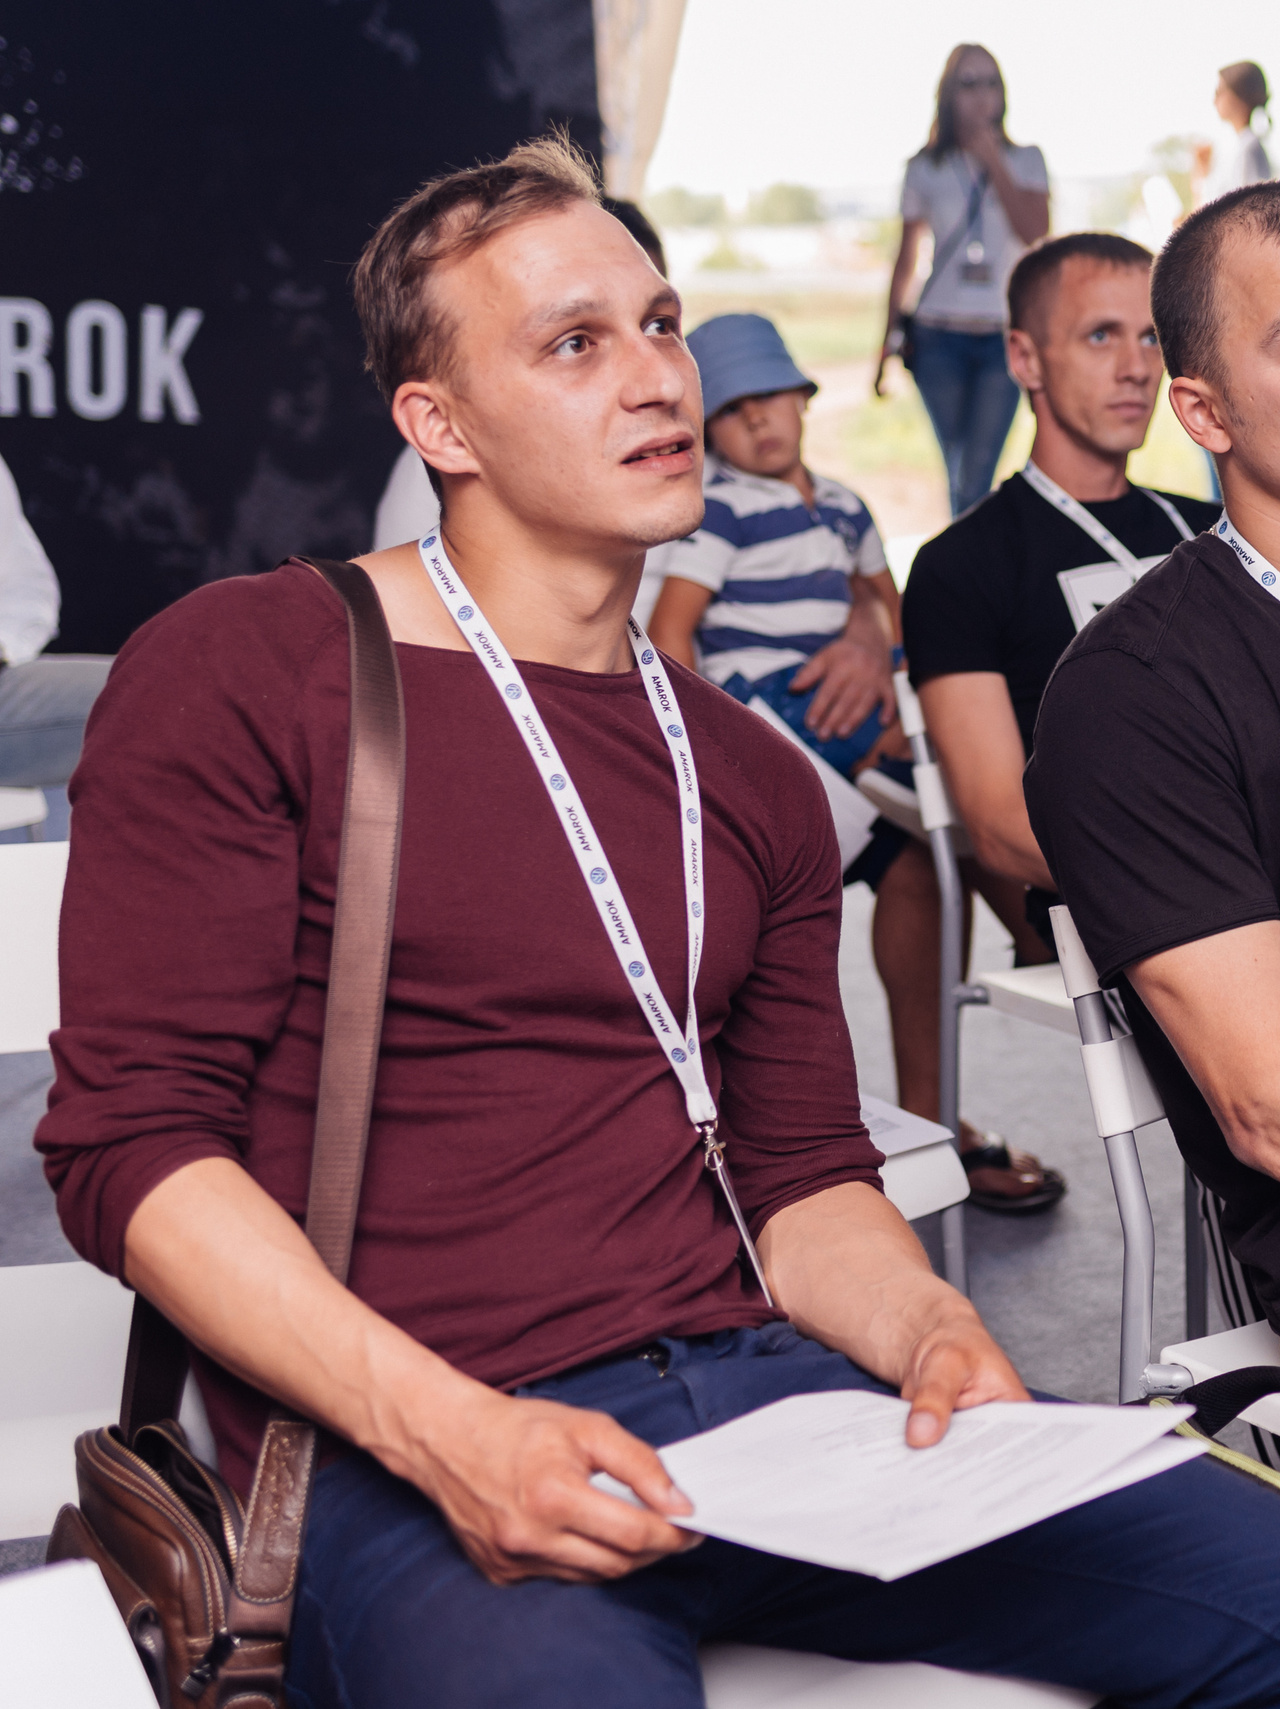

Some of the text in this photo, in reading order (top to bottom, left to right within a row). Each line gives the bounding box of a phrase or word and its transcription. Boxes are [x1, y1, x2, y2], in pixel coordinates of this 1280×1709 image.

[0, 297, 204, 426] ROK
[1228, 536, 1255, 565] AMAROK
[431, 556, 457, 594] AMAROK
[474, 630, 505, 669] AMAROK
[651, 675, 672, 713] AMAROK
[522, 714, 550, 758] AMAROK
[679, 750, 693, 794] AMAROK
[565, 806, 592, 852] AMAROK
[690, 838, 699, 886] AMAROK
[605, 899, 631, 945] AMAROK
[643, 992, 672, 1034] AMAROK
